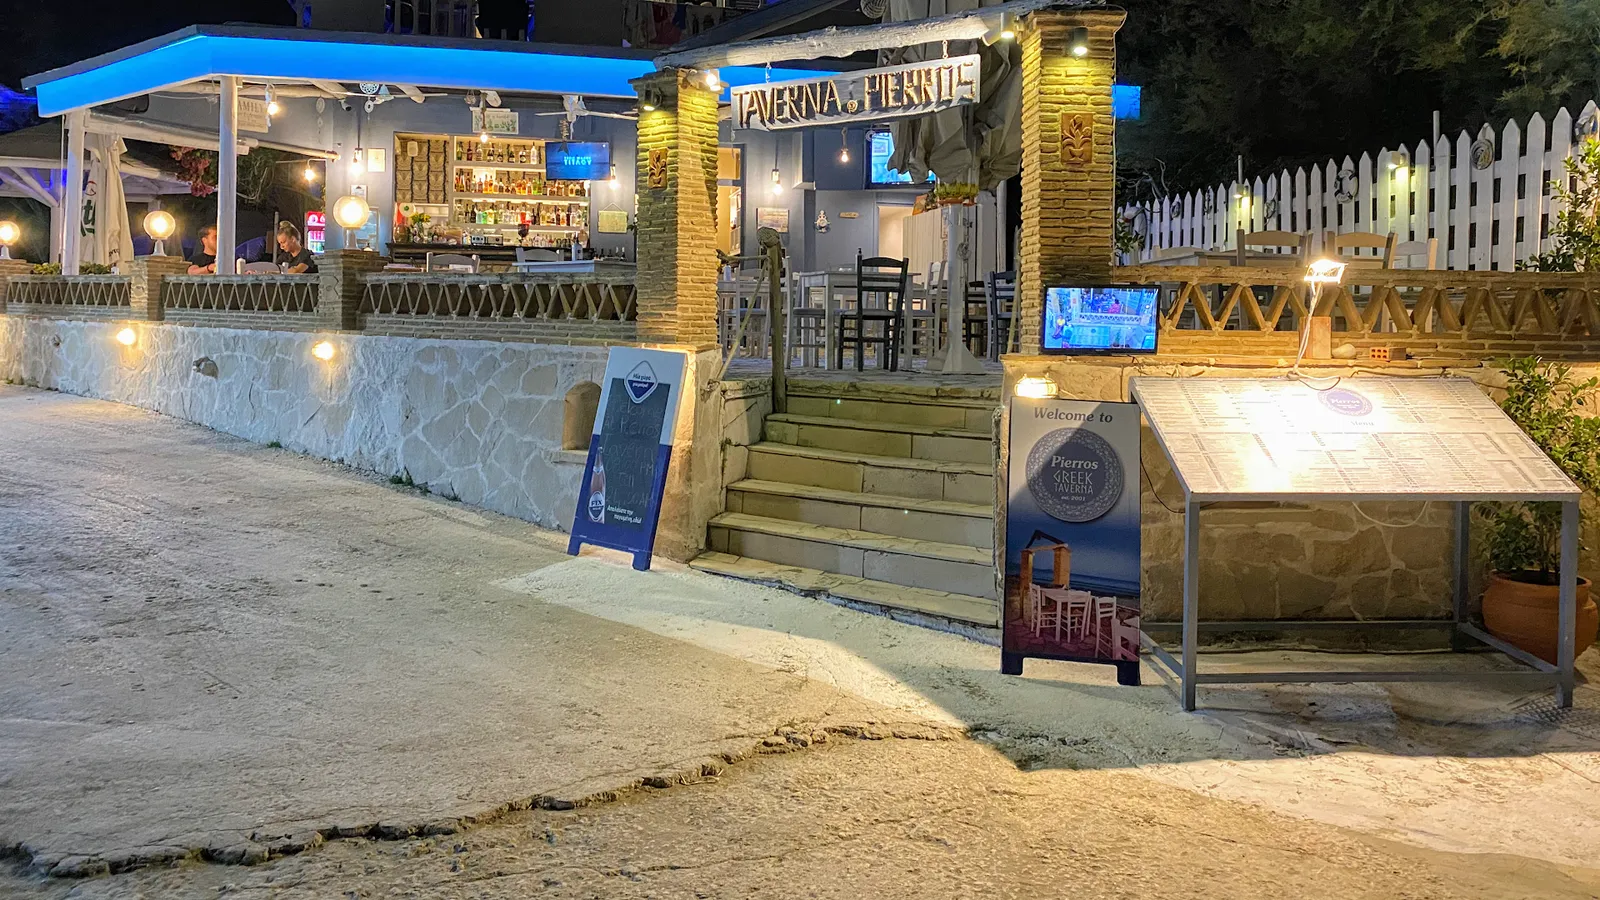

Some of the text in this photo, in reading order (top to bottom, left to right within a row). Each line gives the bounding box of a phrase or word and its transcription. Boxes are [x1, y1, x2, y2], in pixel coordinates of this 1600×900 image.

[731, 62, 977, 126] TAVERNA PIERROS
[237, 100, 263, 113] AMILY
[1034, 407, 1113, 423] Welcome to
[1051, 455, 1099, 470] Pierros
[1053, 469, 1093, 485] GREEK
[1053, 482, 1094, 495] TAVERNA
